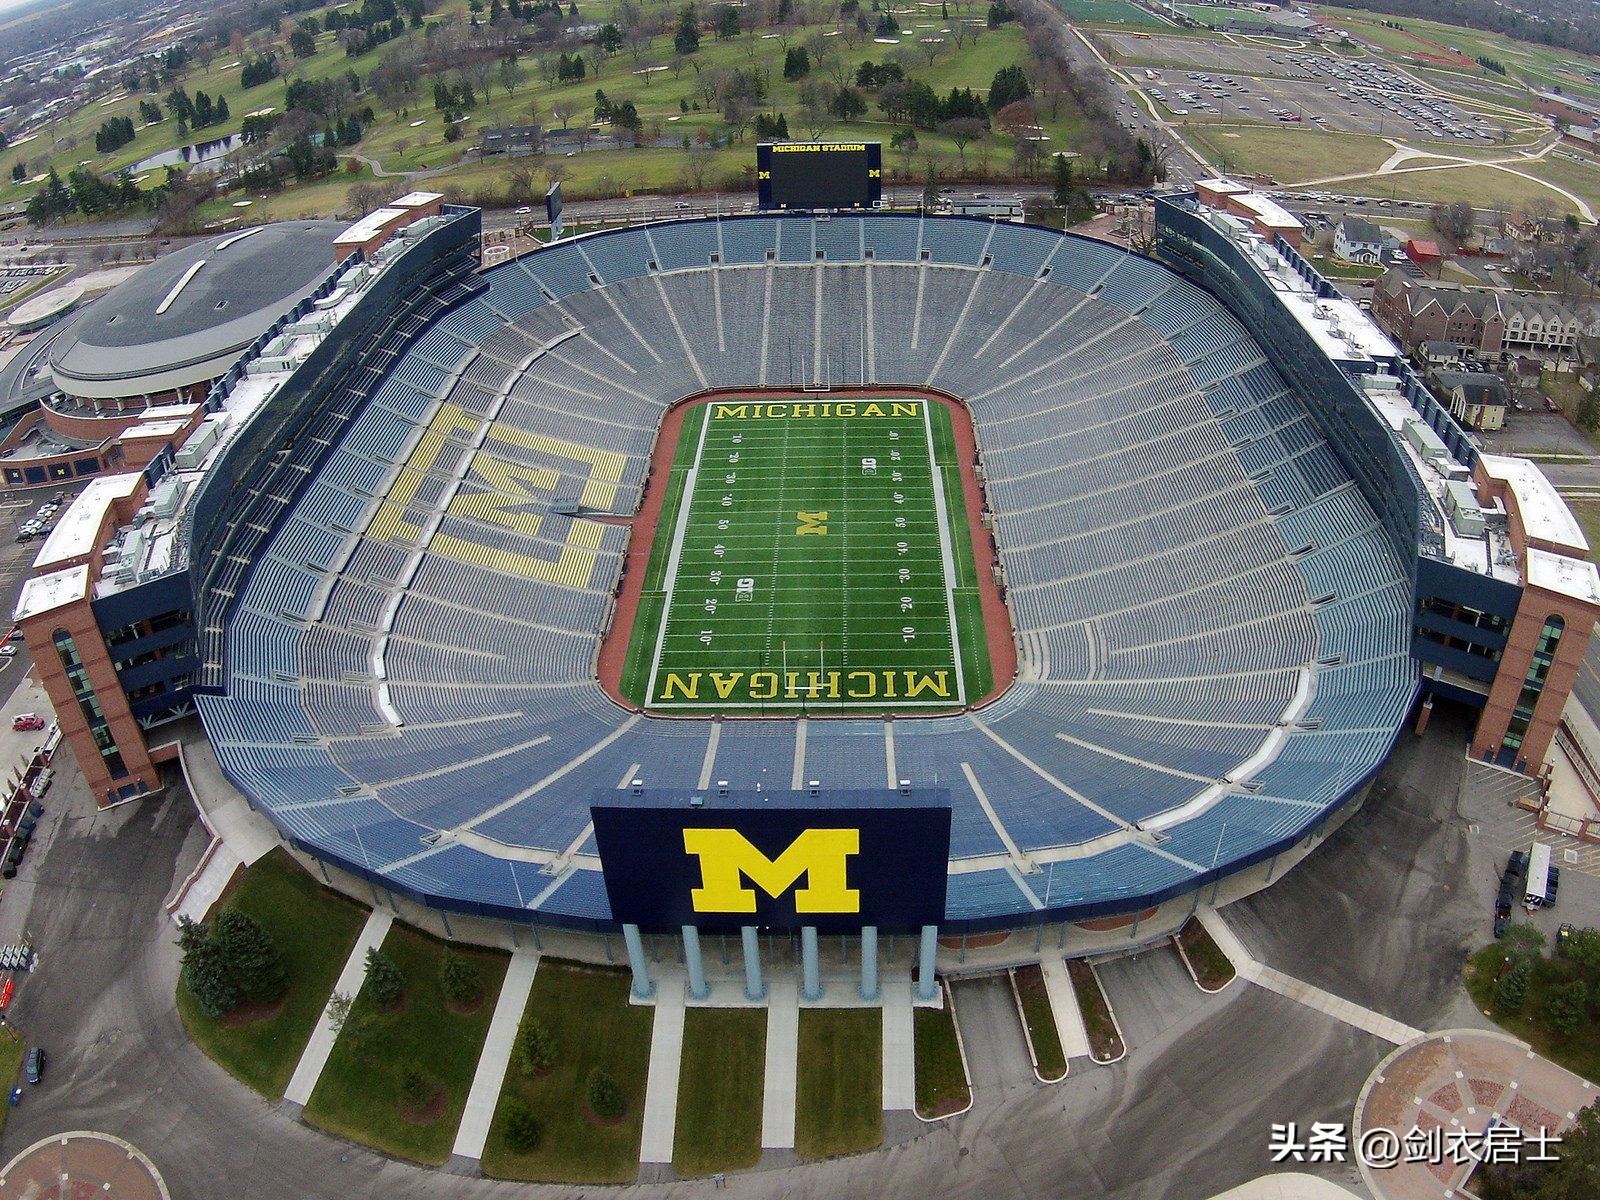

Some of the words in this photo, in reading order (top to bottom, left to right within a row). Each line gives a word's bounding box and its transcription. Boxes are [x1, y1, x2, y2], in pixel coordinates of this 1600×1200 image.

[772, 145, 820, 153] MICHIGAN
[822, 144, 865, 152] STADIUM
[759, 171, 770, 180] M
[868, 169, 880, 178] M
[714, 403, 918, 419] MICHIGAN
[796, 511, 828, 536] M
[709, 570, 721, 582] 30
[898, 568, 910, 580] 30
[704, 599, 718, 611] 20
[900, 596, 913, 609] 20
[699, 630, 712, 642] 10
[902, 627, 915, 639] 10
[659, 671, 950, 698] MICHIGAN
[683, 828, 860, 913] M
